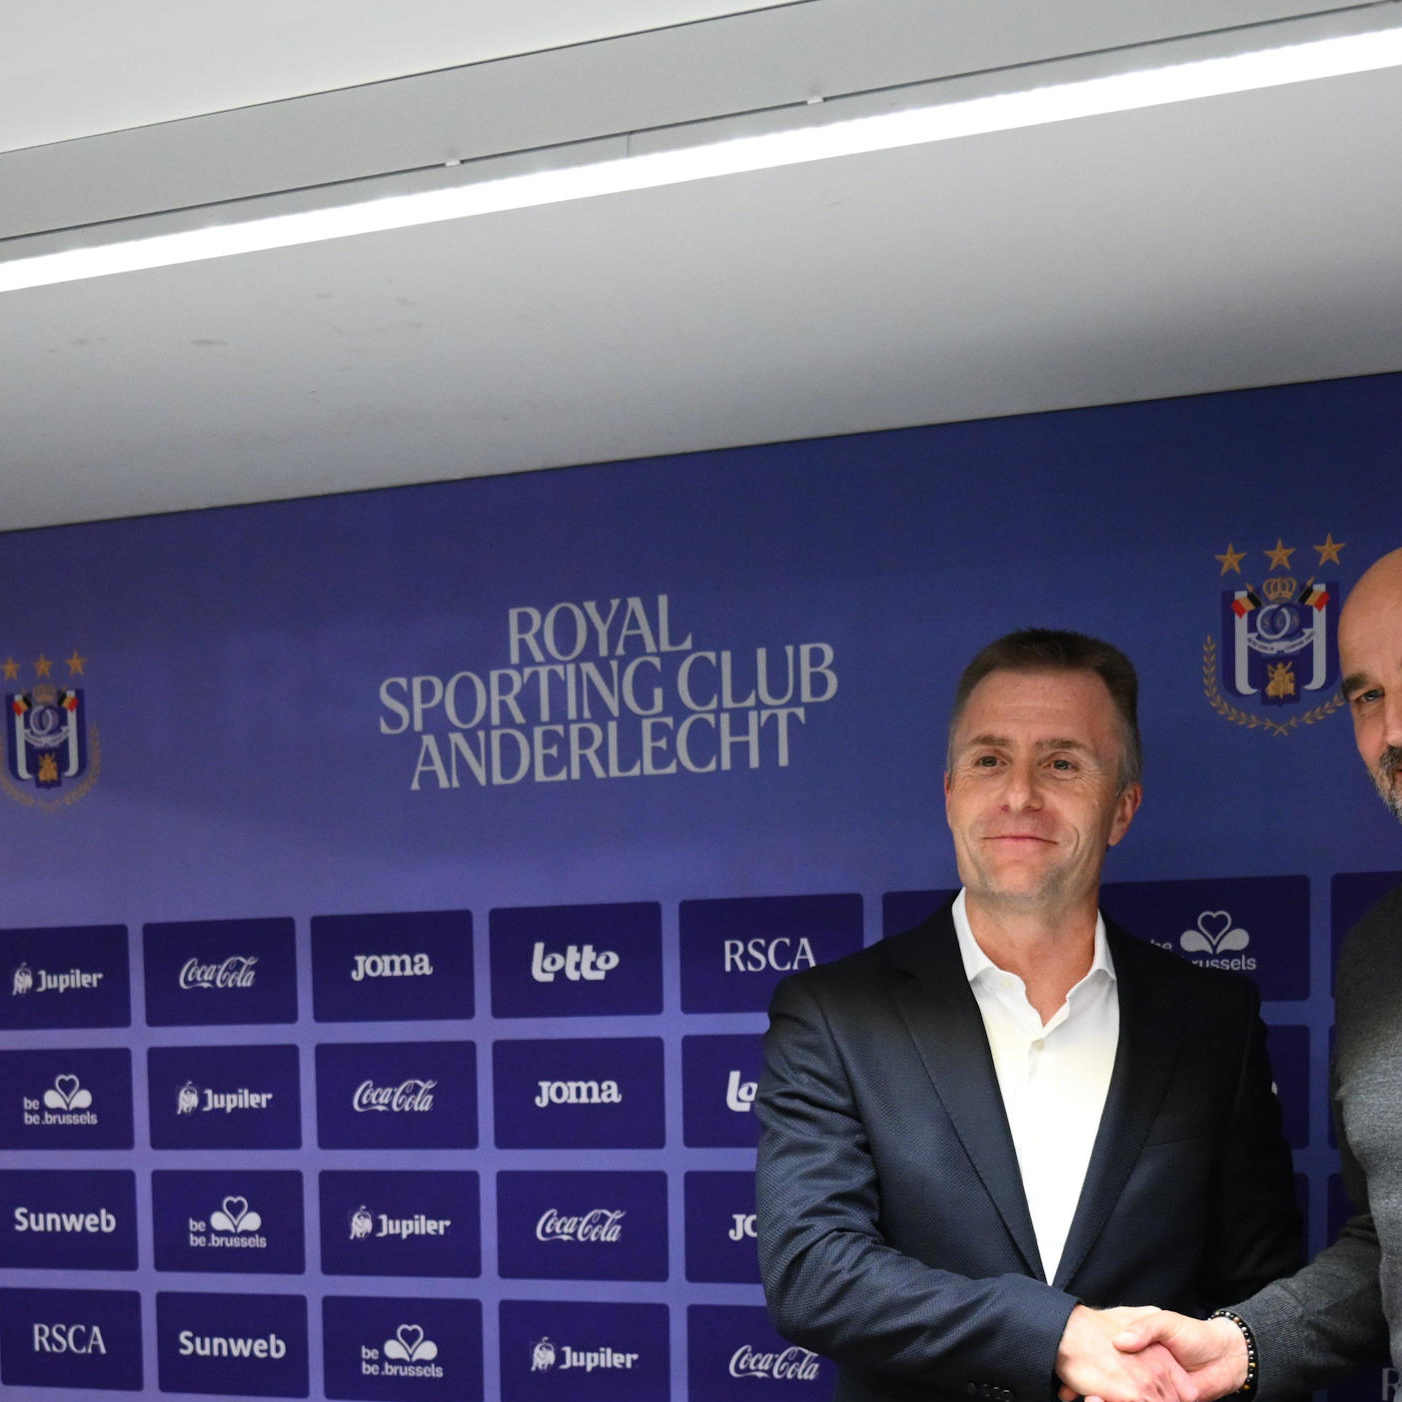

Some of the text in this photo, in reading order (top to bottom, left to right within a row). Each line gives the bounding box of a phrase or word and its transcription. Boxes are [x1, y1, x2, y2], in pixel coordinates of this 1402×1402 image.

[508, 594, 692, 665] ROYAL
[379, 643, 838, 735] SPORTING CLUB
[410, 707, 807, 790] ANDERLECHT
[724, 937, 817, 973] RSCA
[37, 968, 104, 993] Jupiler
[178, 956, 259, 990] Coca-Cola
[23, 1097, 40, 1110] be
[202, 1088, 274, 1114] Jupiler
[352, 1079, 438, 1113] Coca-Cola
[13, 1206, 117, 1233] Sunweb
[189, 1218, 206, 1231] be
[376, 1212, 452, 1239] Jupiler
[535, 1208, 626, 1243] Coca-Cola
[33, 1323, 107, 1355] RSCA
[178, 1330, 287, 1360] Sunweb
[361, 1345, 379, 1359] be
[559, 1345, 639, 1372] Jupiler
[728, 1344, 820, 1381] Coca-Cola
